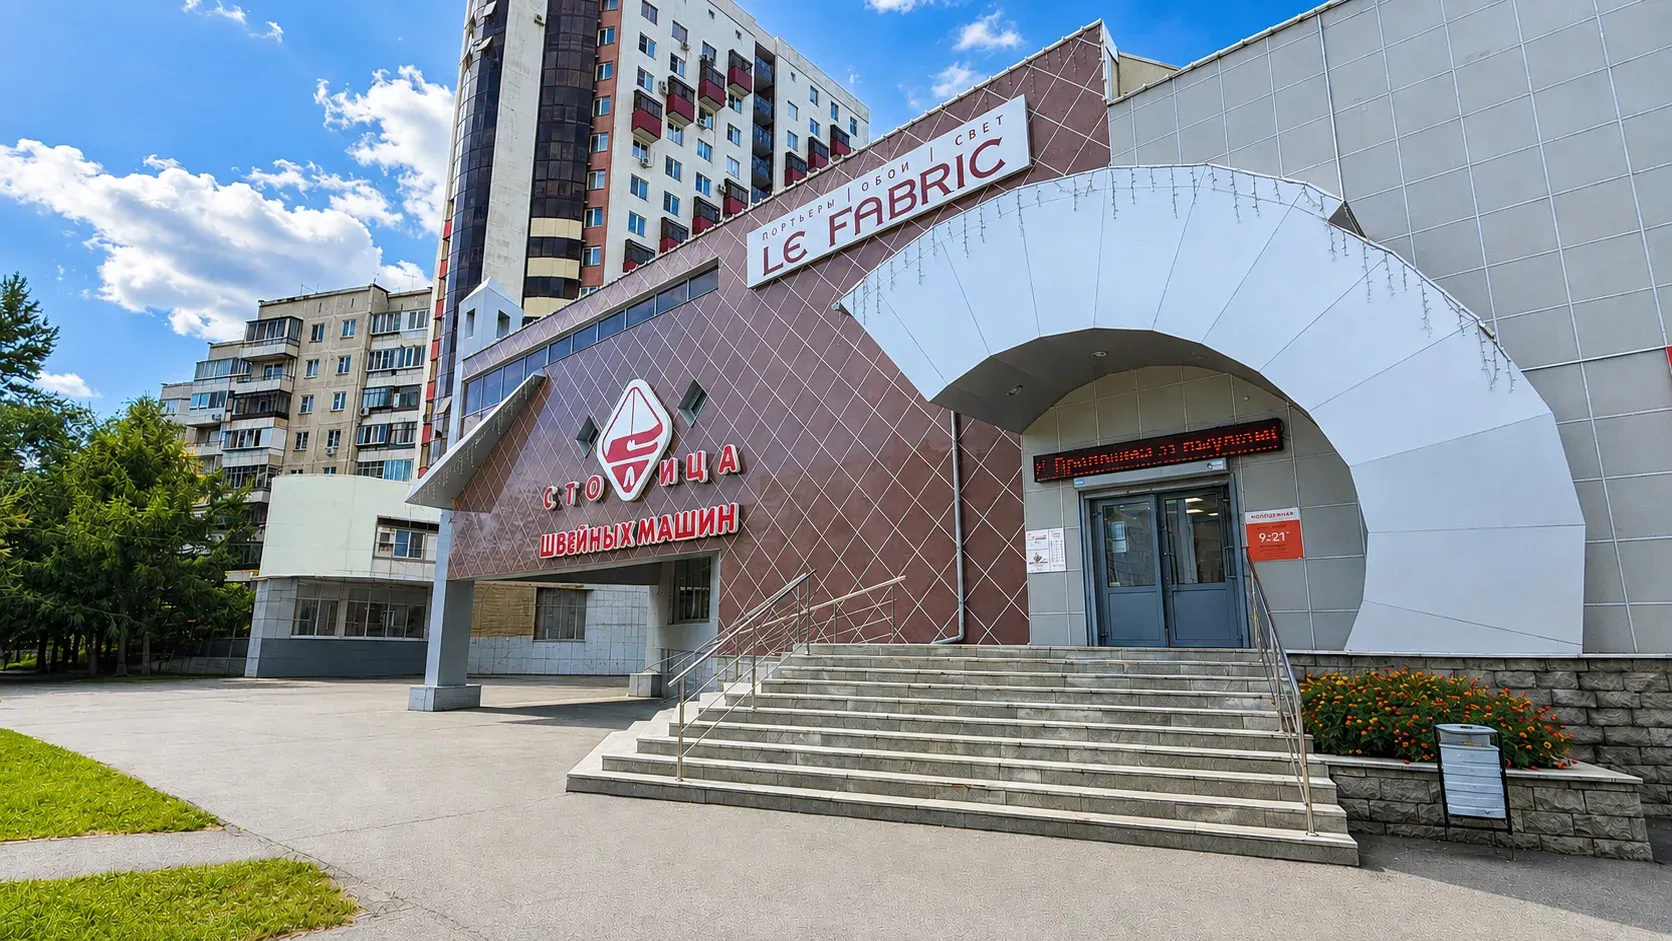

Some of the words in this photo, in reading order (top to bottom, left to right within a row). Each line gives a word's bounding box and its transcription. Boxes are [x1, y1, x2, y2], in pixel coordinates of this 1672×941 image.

[762, 198, 836, 241] ПОРТЬЕРЫ
[861, 161, 910, 193] ОБОИ
[955, 114, 1004, 146] СВЕТ
[763, 230, 808, 276] LE
[828, 137, 1006, 248] FABRIC
[539, 521, 636, 558] ШВЕЙНЫХ
[637, 502, 740, 545] МАШИН
